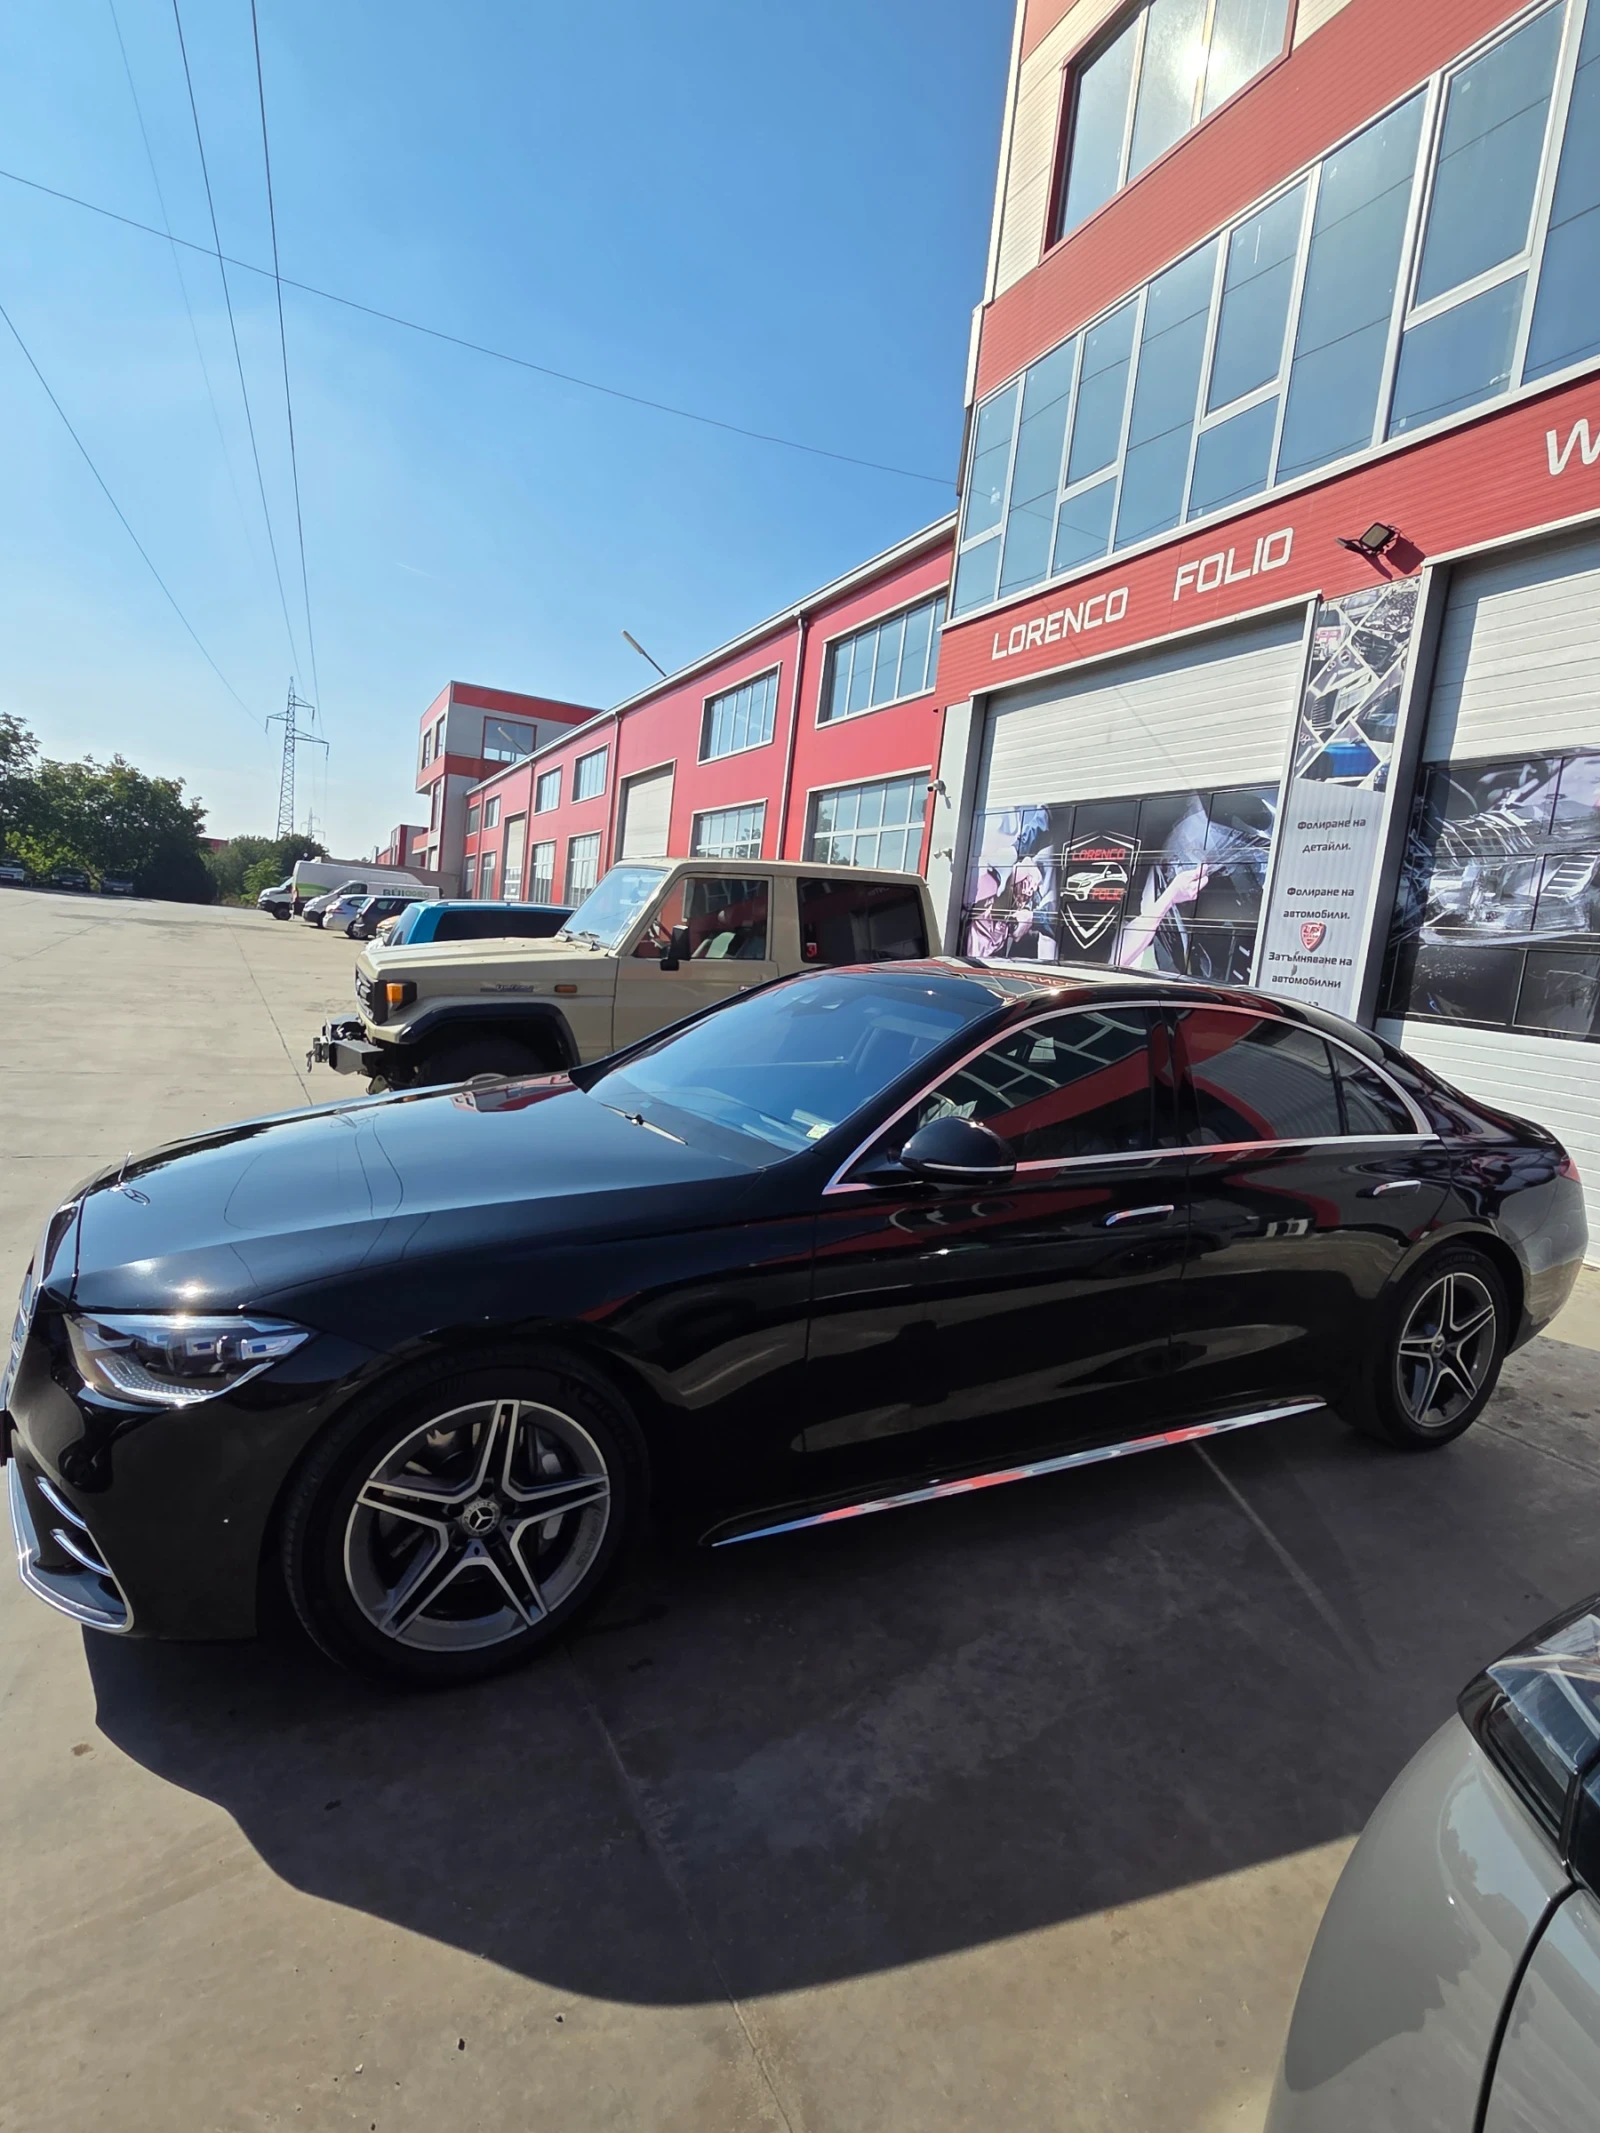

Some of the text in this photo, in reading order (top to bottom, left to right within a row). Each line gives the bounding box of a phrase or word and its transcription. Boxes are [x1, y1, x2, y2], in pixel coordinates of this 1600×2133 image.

[991, 527, 1295, 661] LORENCO FOLIO
[1297, 819, 1366, 830] Фолиране на
[1302, 841, 1351, 853] детайли.
[1072, 848, 1126, 861] LORENCO
[1286, 887, 1355, 898] Фолиране на
[1283, 909, 1351, 920] автомобили.
[1268, 951, 1353, 966] Затъмняване на
[1271, 975, 1342, 989] автомобилни
